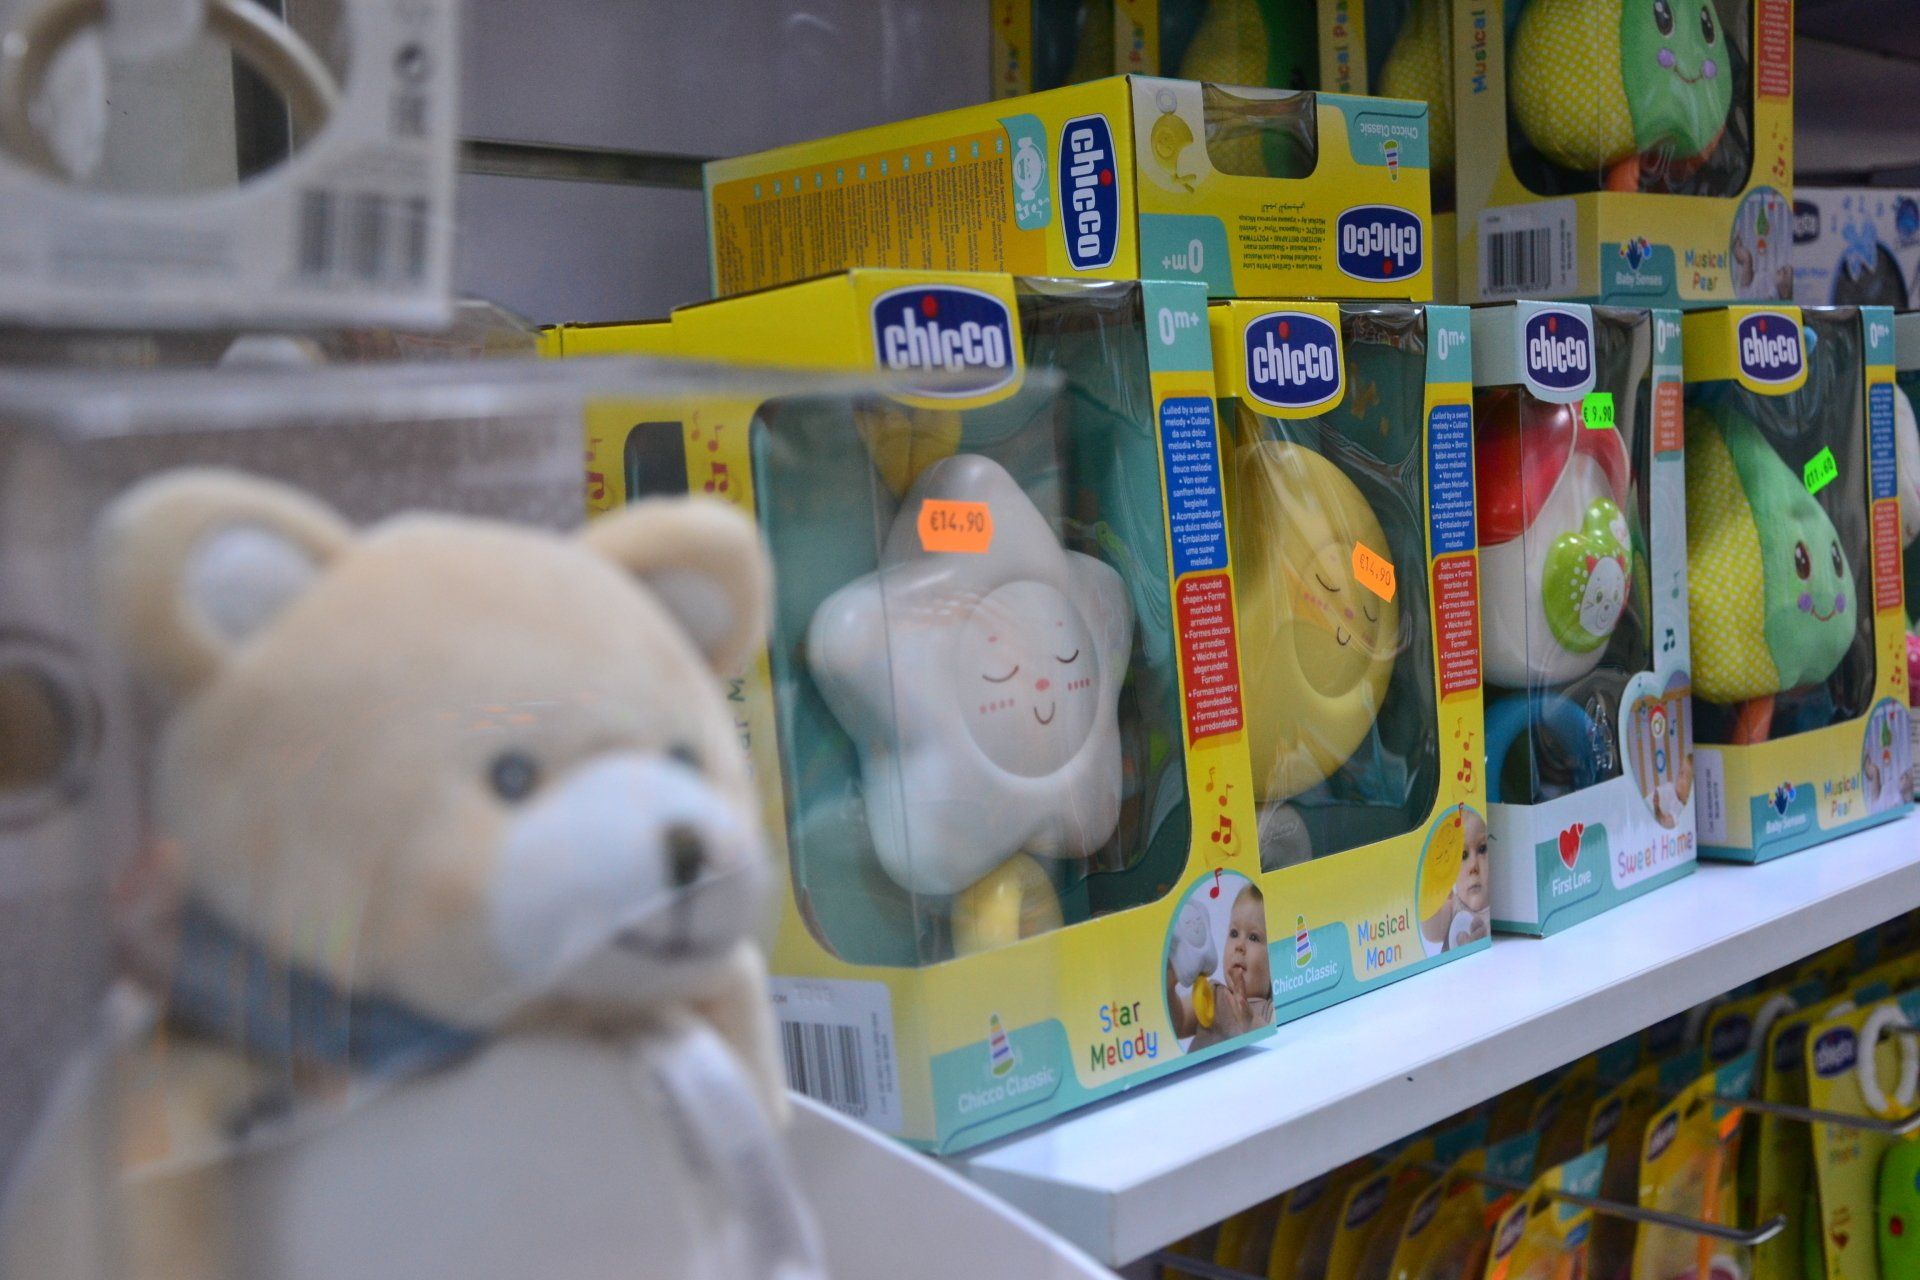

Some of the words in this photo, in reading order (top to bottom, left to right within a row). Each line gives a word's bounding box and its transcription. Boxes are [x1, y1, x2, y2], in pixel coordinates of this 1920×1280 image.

[1471, 10, 1487, 94] Musical
[1360, 122, 1390, 137] Classic
[1391, 125, 1418, 139] Chicco
[1071, 128, 1112, 258] chicco
[1343, 222, 1417, 276] chicco
[1685, 249, 1727, 269] Musical
[1693, 271, 1718, 291] Pear
[884, 295, 1006, 373] chicco
[1158, 307, 1200, 346] 0m+
[1658, 318, 1681, 354] 0m+
[1253, 321, 1334, 386] chicco
[1437, 328, 1466, 361] 0m+
[1530, 316, 1587, 373] chicco
[1743, 319, 1798, 369] chicco
[1163, 406, 1181, 415] Lulled
[1182, 405, 1188, 416] by
[1194, 405, 1210, 414] sweet
[1165, 417, 1186, 428] melody
[1191, 416, 1210, 425] Cullato
[1168, 441, 1191, 450] melodia
[1195, 439, 1211, 448] Berce
[1172, 429, 1179, 438] da
[1180, 430, 1191, 438] una
[1192, 428, 1206, 437] dolce
[1173, 465, 1190, 473] douce
[1182, 476, 1194, 484] Von
[1173, 488, 1194, 497] sanften
[1195, 486, 1216, 495] Melodie
[1183, 499, 1208, 509] begleitet
[1212, 510, 1221, 518] por
[1173, 525, 1184, 533] una
[1185, 523, 1200, 532] dulce
[1182, 534, 1210, 544] Embalado
[1211, 533, 1219, 541] por
[1186, 548, 1198, 556] uma
[1199, 546, 1215, 554] suave
[1190, 557, 1212, 566] melodia
[1824, 772, 1860, 798] Musical
[1617, 838, 1657, 878] Sweet
[1661, 831, 1694, 860] Home
[1552, 875, 1573, 898] First
[1573, 870, 1592, 889] Love
[1357, 908, 1411, 946] Musical
[1365, 944, 1403, 971] Moon
[1272, 973, 1304, 996] Chicco
[1305, 961, 1338, 984] Classic
[1100, 1001, 1140, 1032] Star
[1090, 1028, 1158, 1072] Melody
[958, 1080, 1005, 1114] Chicco
[1006, 1066, 1054, 1097] Classic
